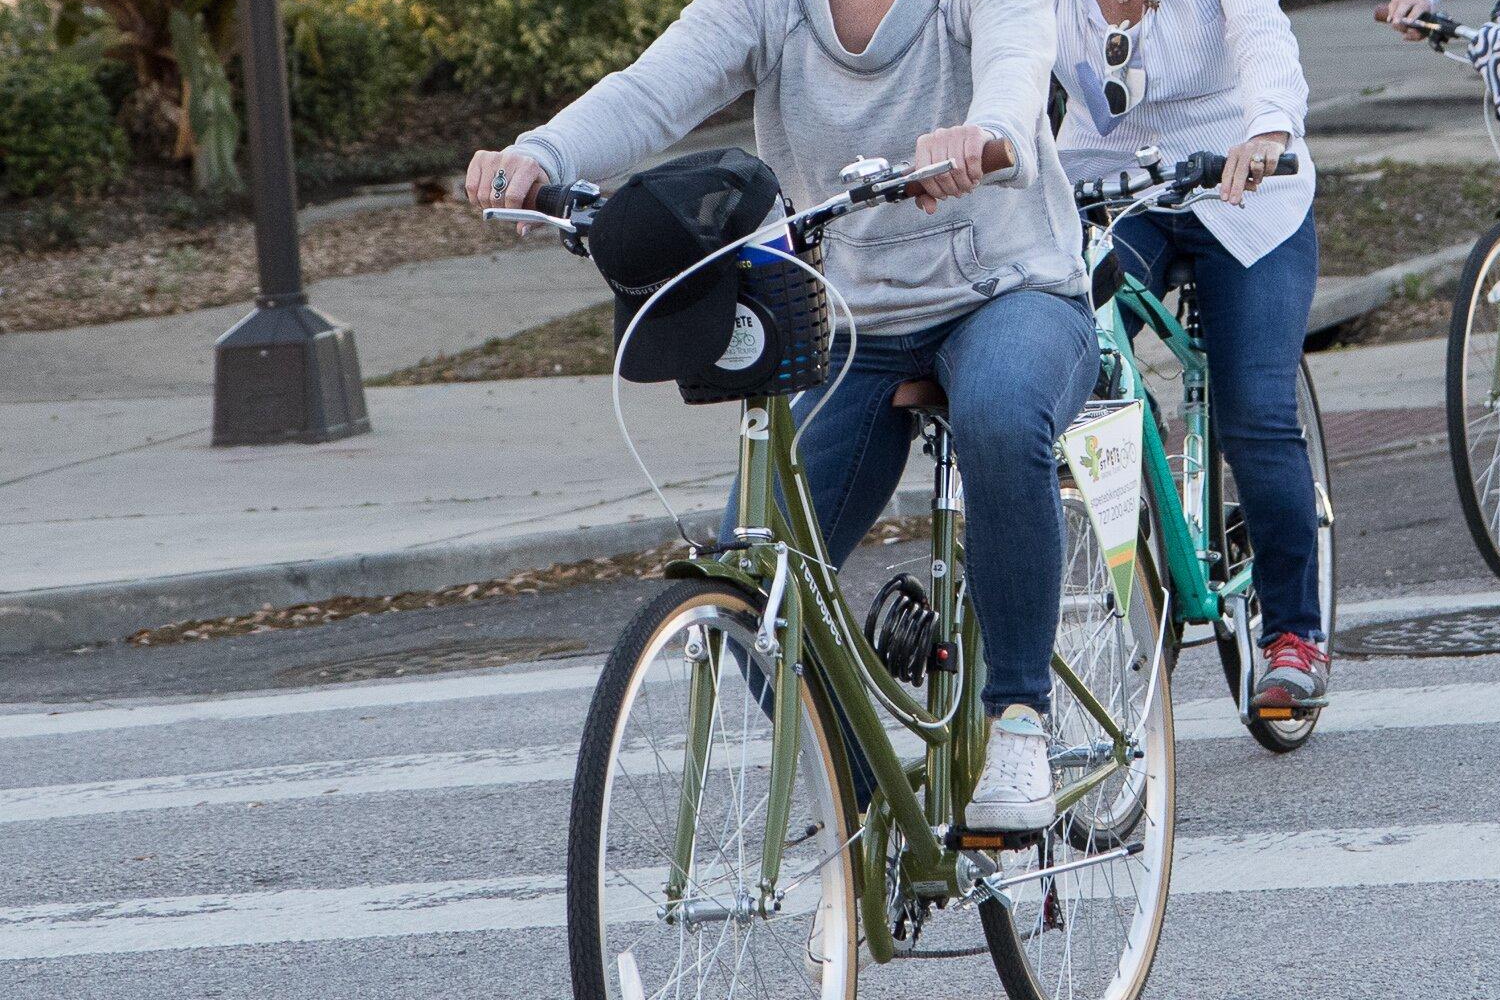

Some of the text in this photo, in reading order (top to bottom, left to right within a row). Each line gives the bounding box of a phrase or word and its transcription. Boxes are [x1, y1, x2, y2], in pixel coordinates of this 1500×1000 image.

[735, 315, 754, 328] ETE
[1105, 447, 1120, 466] PETE
[933, 564, 943, 572] 42
